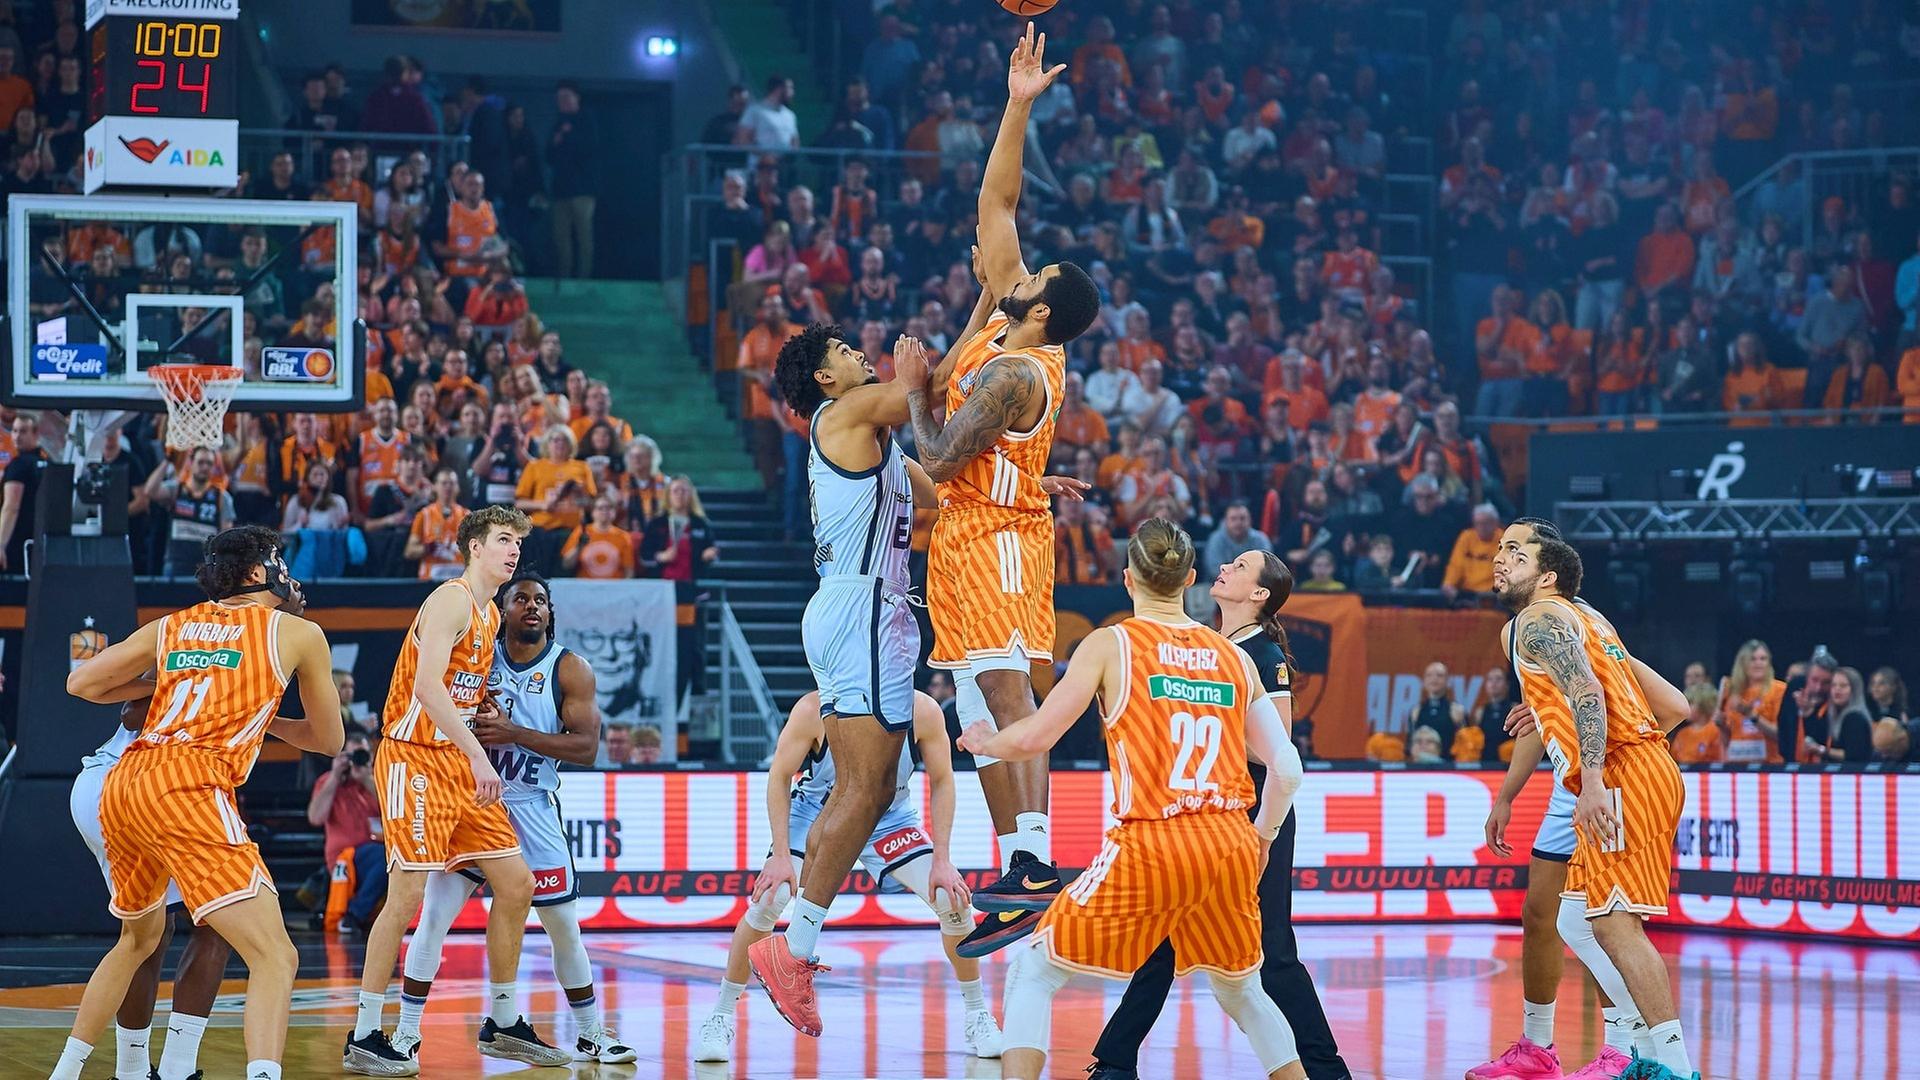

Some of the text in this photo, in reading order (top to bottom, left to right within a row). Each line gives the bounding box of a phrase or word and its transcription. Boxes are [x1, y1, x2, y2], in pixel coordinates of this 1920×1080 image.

[135, 22, 221, 58] 10:00
[131, 60, 211, 113] 24
[169, 149, 224, 167] AIDA
[56, 359, 103, 373] Credit
[1158, 642, 1219, 671] KLEPEISZ
[450, 685, 477, 700] MOLY
[454, 673, 482, 688] LIQUI
[1163, 679, 1222, 703] Oscorna
[1366, 673, 1484, 733] ARY
[1169, 712, 1222, 792] 22
[486, 747, 544, 785] WE
[412, 794, 425, 843] Allianz
[883, 831, 922, 855] cewe
[611, 874, 683, 895] AUF
[1331, 868, 1517, 889] UUUULMER
[1733, 874, 1767, 896] AUF
[1771, 877, 1830, 899] GEHTS
